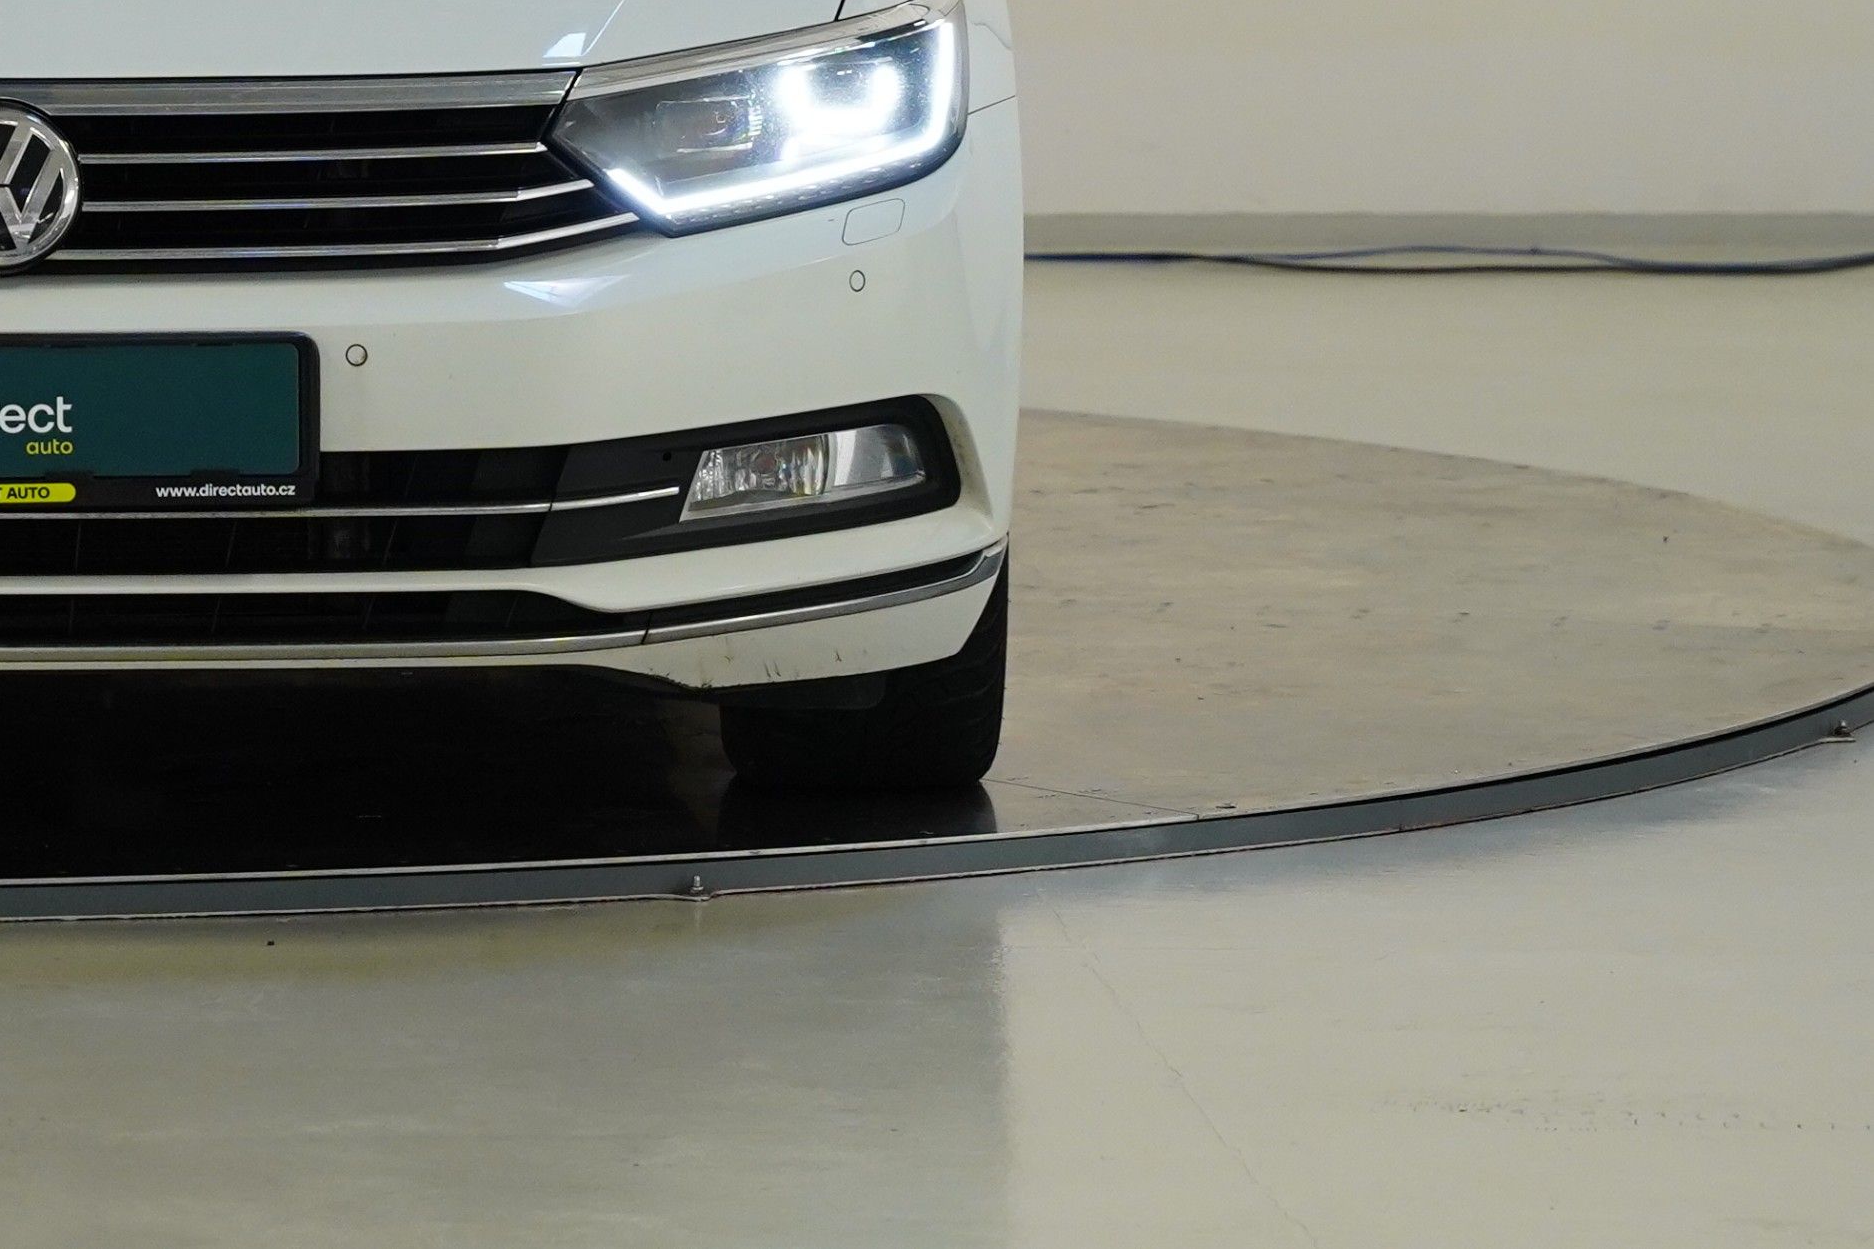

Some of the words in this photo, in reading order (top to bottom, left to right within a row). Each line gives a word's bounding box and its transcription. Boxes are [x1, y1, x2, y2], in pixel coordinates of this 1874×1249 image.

[26, 439, 73, 455] auto
[7, 486, 50, 499] AUTO
[155, 483, 296, 497] www.directauto.cz
